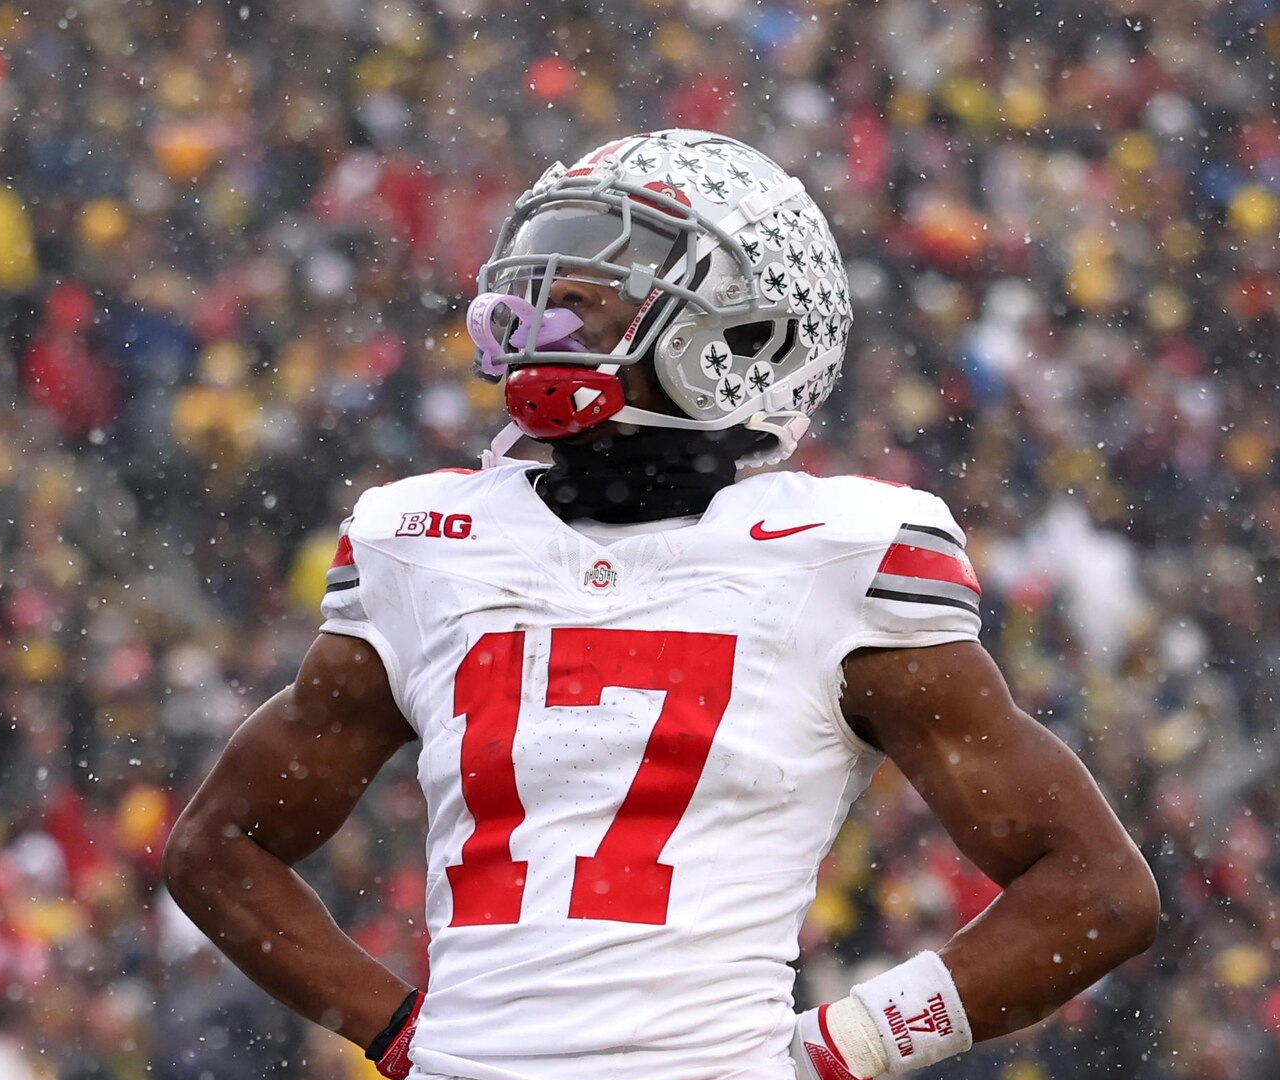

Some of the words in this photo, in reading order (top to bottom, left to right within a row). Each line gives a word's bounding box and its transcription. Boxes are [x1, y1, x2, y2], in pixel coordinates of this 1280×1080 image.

[641, 289, 660, 313] STAT
[445, 627, 738, 928] 17
[905, 1008, 936, 1032] 17
[927, 992, 954, 1037] TOUCH
